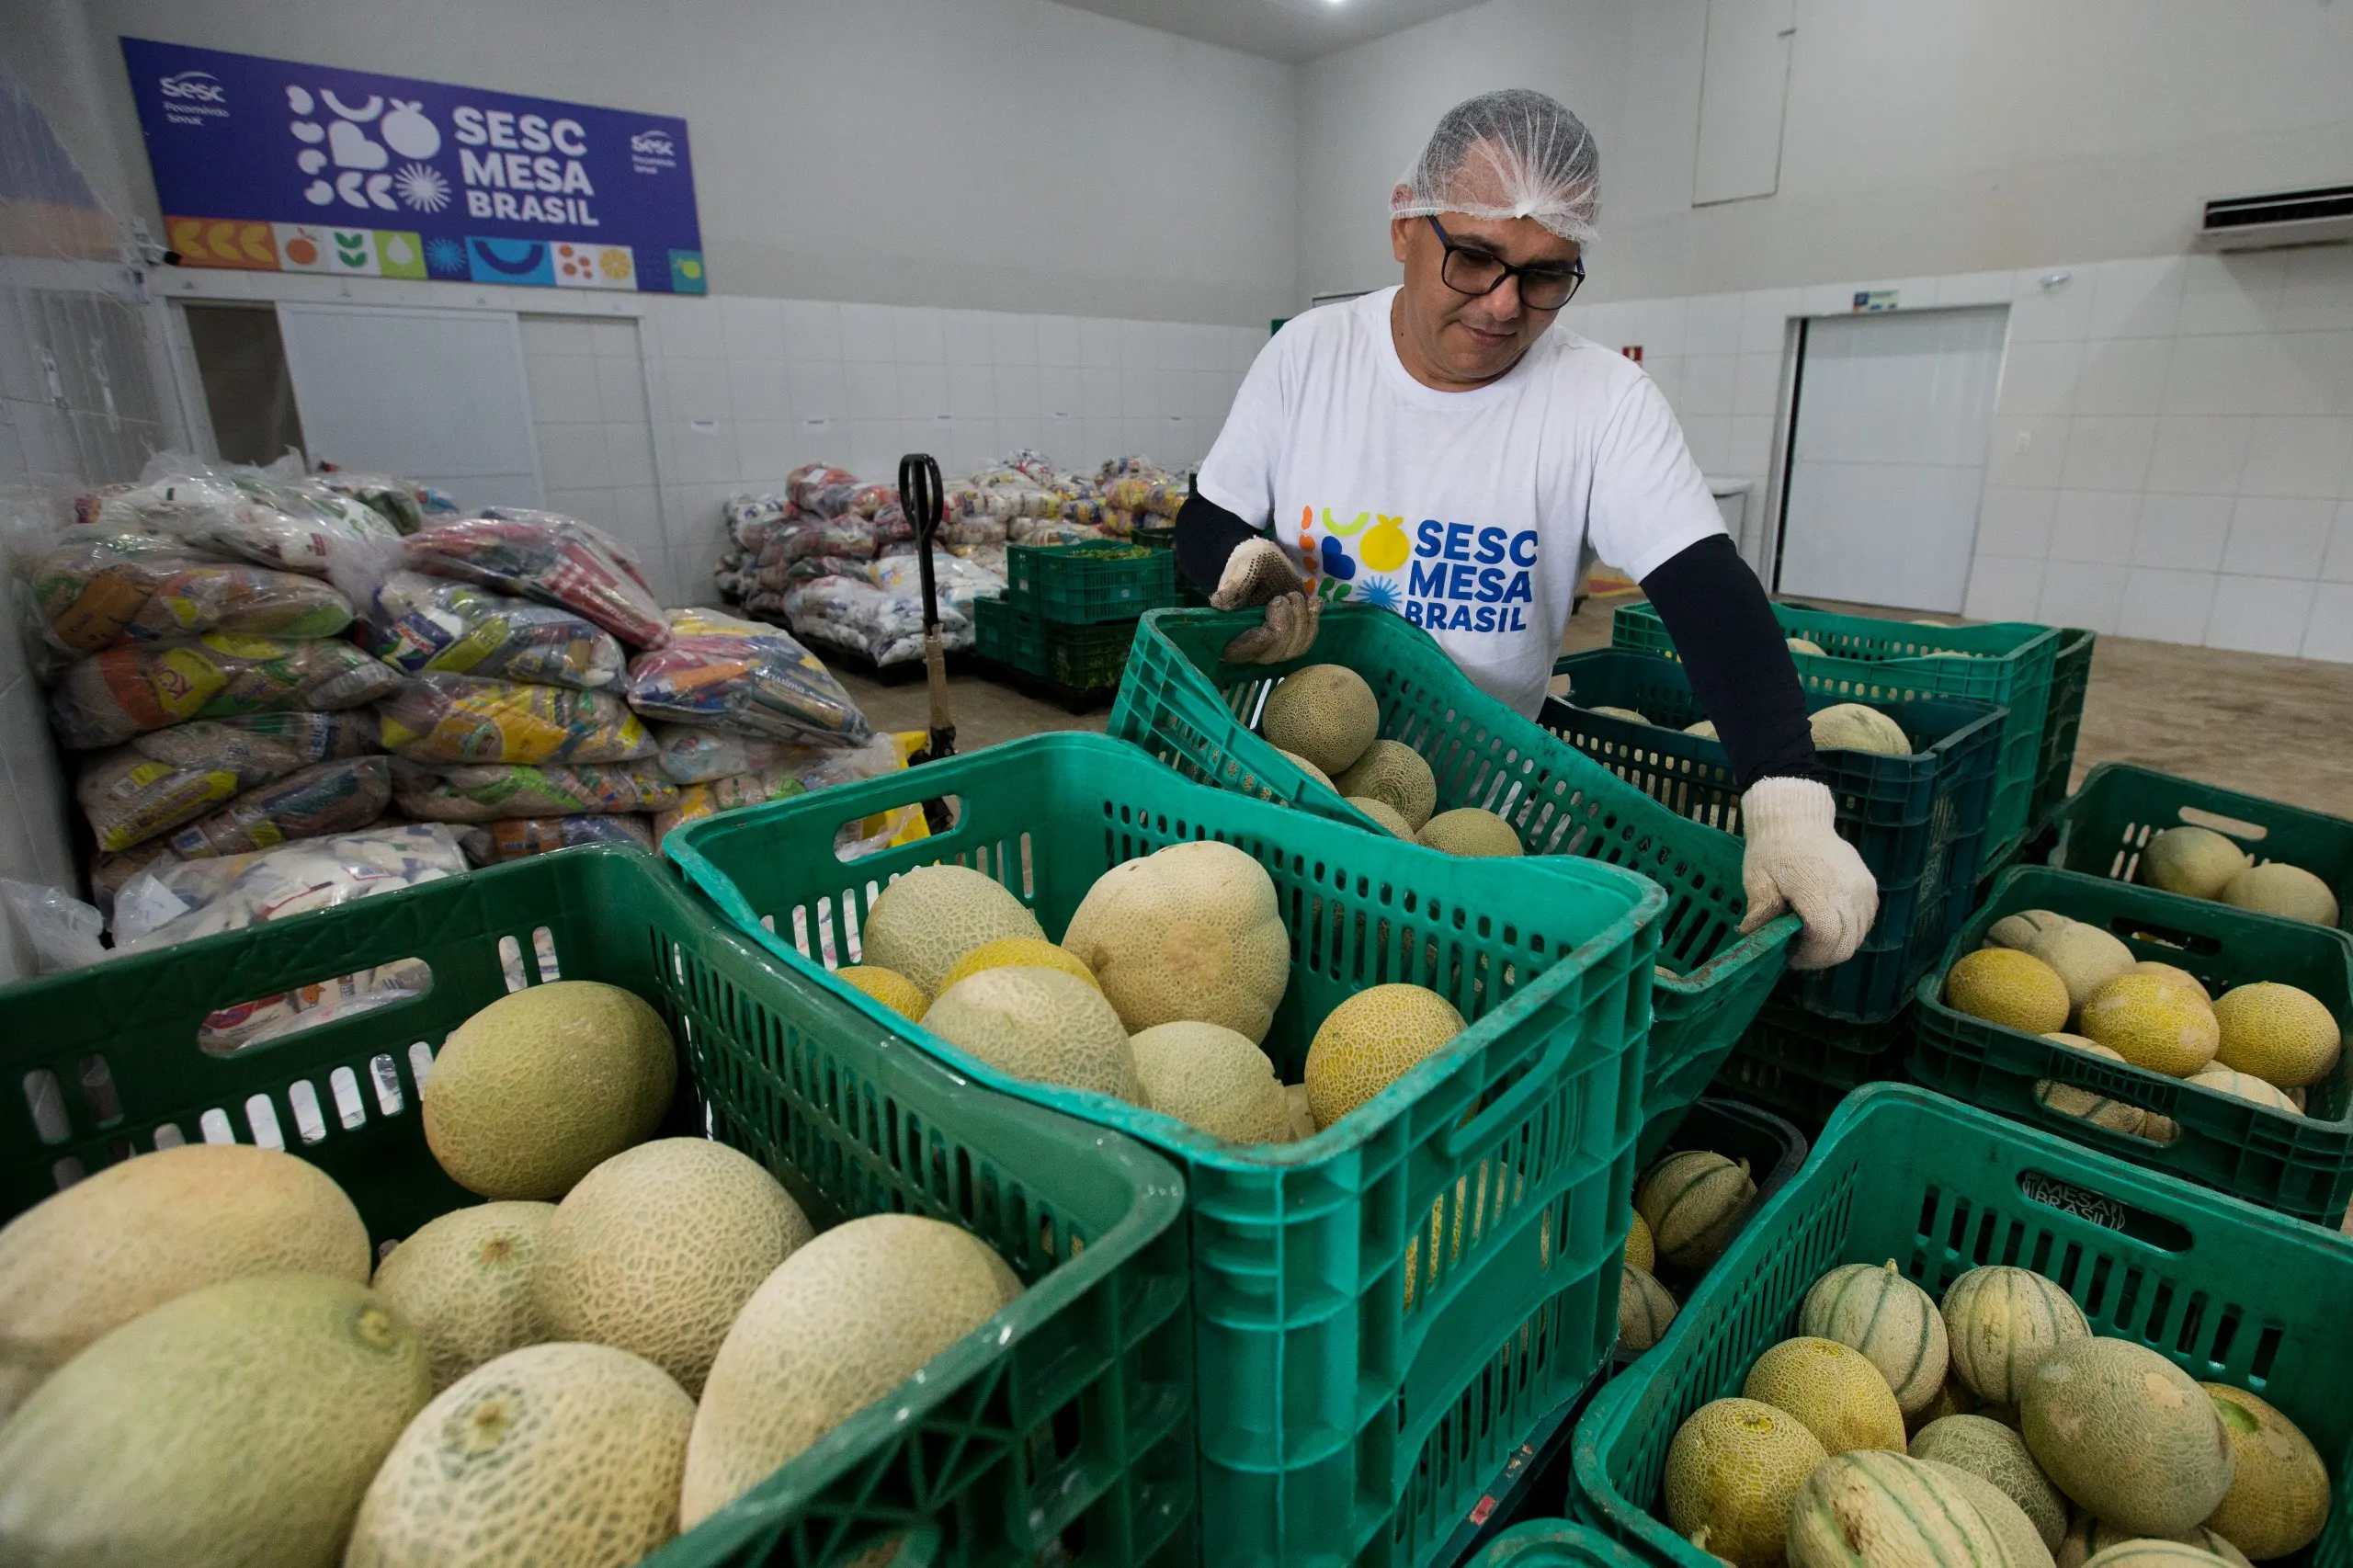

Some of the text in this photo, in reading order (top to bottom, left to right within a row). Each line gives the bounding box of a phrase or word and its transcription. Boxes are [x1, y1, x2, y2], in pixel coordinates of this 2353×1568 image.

[160, 72, 226, 102] Sesc
[453, 106, 586, 156] SESC
[460, 148, 595, 196] MESA
[467, 190, 599, 226] BRASIL
[1415, 519, 1539, 568] SESC
[1408, 560, 1533, 604] MESA
[1404, 599, 1527, 633] BRASIL
[2038, 1179, 2110, 1217] MESA
